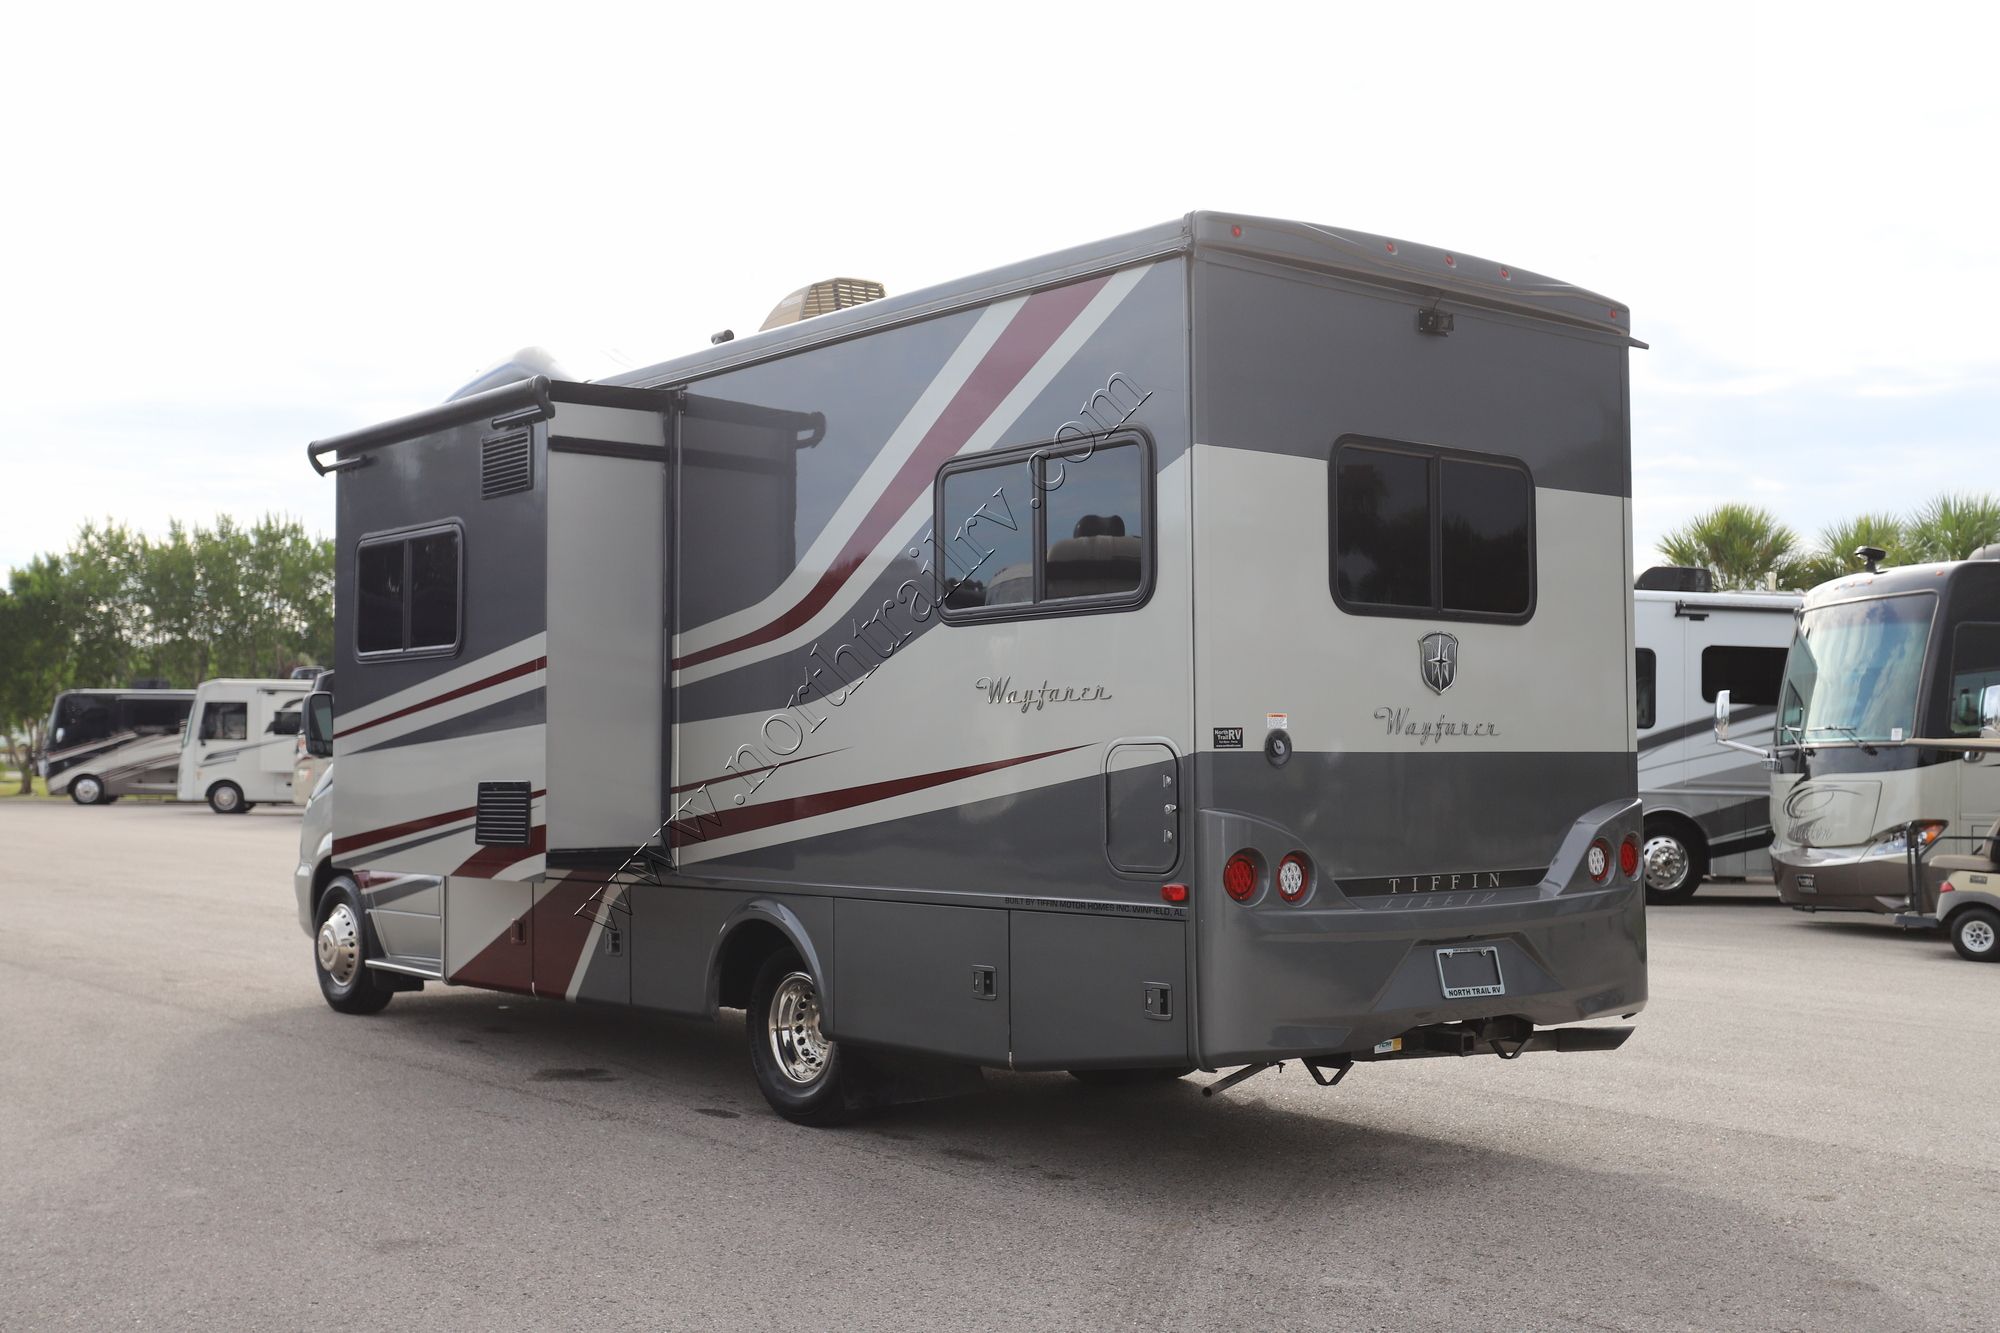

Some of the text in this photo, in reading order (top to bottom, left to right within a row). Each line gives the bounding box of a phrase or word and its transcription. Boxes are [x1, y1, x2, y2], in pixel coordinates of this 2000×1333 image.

[976, 676, 1112, 713] Wayfarer
[1228, 729, 1242, 740] RV
[1374, 706, 1501, 745] Wayfarer
[1388, 873, 1501, 894] TIFFIN
[1005, 897, 1024, 905] BUILT
[1026, 898, 1036, 906] BY
[1035, 899, 1058, 908] TIFFIN
[1060, 901, 1086, 910] MOTOR
[1088, 902, 1115, 912] HOMES
[1174, 908, 1185, 917] AL
[1448, 986, 1501, 997] NORTH TRAIL RV
